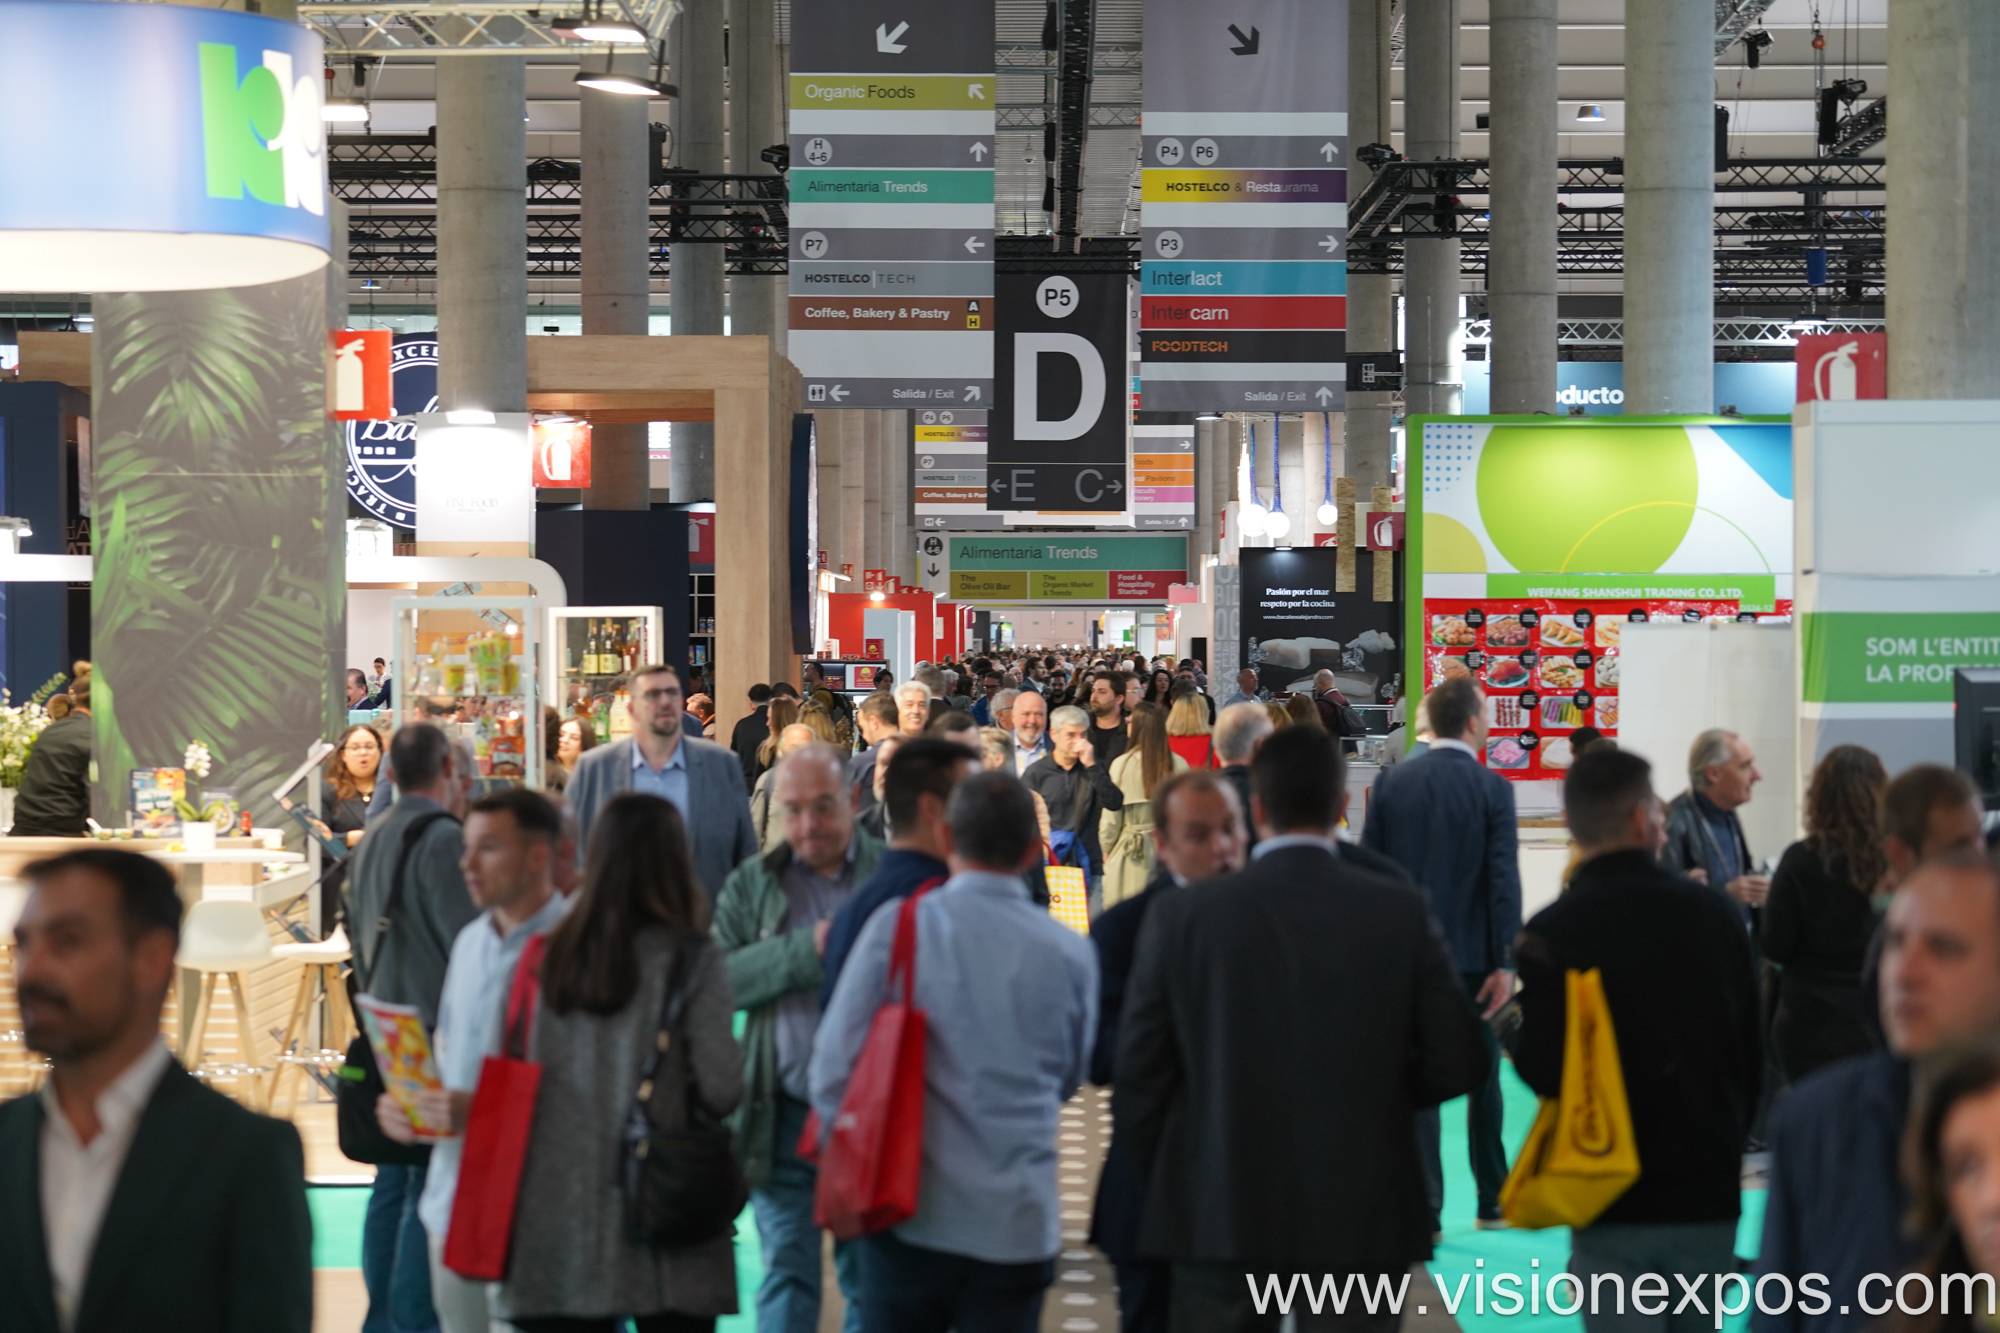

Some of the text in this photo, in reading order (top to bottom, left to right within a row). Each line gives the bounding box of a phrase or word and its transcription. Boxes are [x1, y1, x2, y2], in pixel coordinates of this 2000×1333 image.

[805, 84, 915, 101] Organic Foods
[814, 140, 823, 149] H
[809, 152, 828, 162] 4-6
[1161, 146, 1214, 158] P4 P6
[808, 181, 928, 192] Alimentaria Trends
[1166, 182, 1319, 192] HOSTELCO & Restaurama
[806, 240, 824, 250] P7
[1160, 239, 1178, 250] P3
[804, 274, 916, 284] HOSTELCO TECH
[1152, 270, 1223, 286] Interlact
[1045, 290, 1070, 306] P5
[968, 302, 978, 311] A
[805, 308, 950, 320] Coffee, Bakery & Pastry
[1152, 305, 1229, 320] Intercarn
[970, 318, 977, 326] H
[1152, 341, 1228, 352] FOODTECH
[1014, 332, 1106, 441] D
[892, 389, 926, 399] Salida
[936, 389, 954, 399] Exit
[1244, 392, 1278, 401] Salida
[1287, 392, 1306, 401] Exit
[1011, 469, 1036, 502] E
[1074, 468, 1104, 502] C
[960, 546, 1098, 559] Alimentaria Trends
[1528, 588, 1580, 598] WEIFANG
[1583, 588, 1641, 598] SHANSHUI
[1644, 588, 1696, 598] TRADING
[1260, 601, 1287, 609] respeto
[1866, 637, 1917, 656] SOM
[1866, 664, 1893, 682] LA
